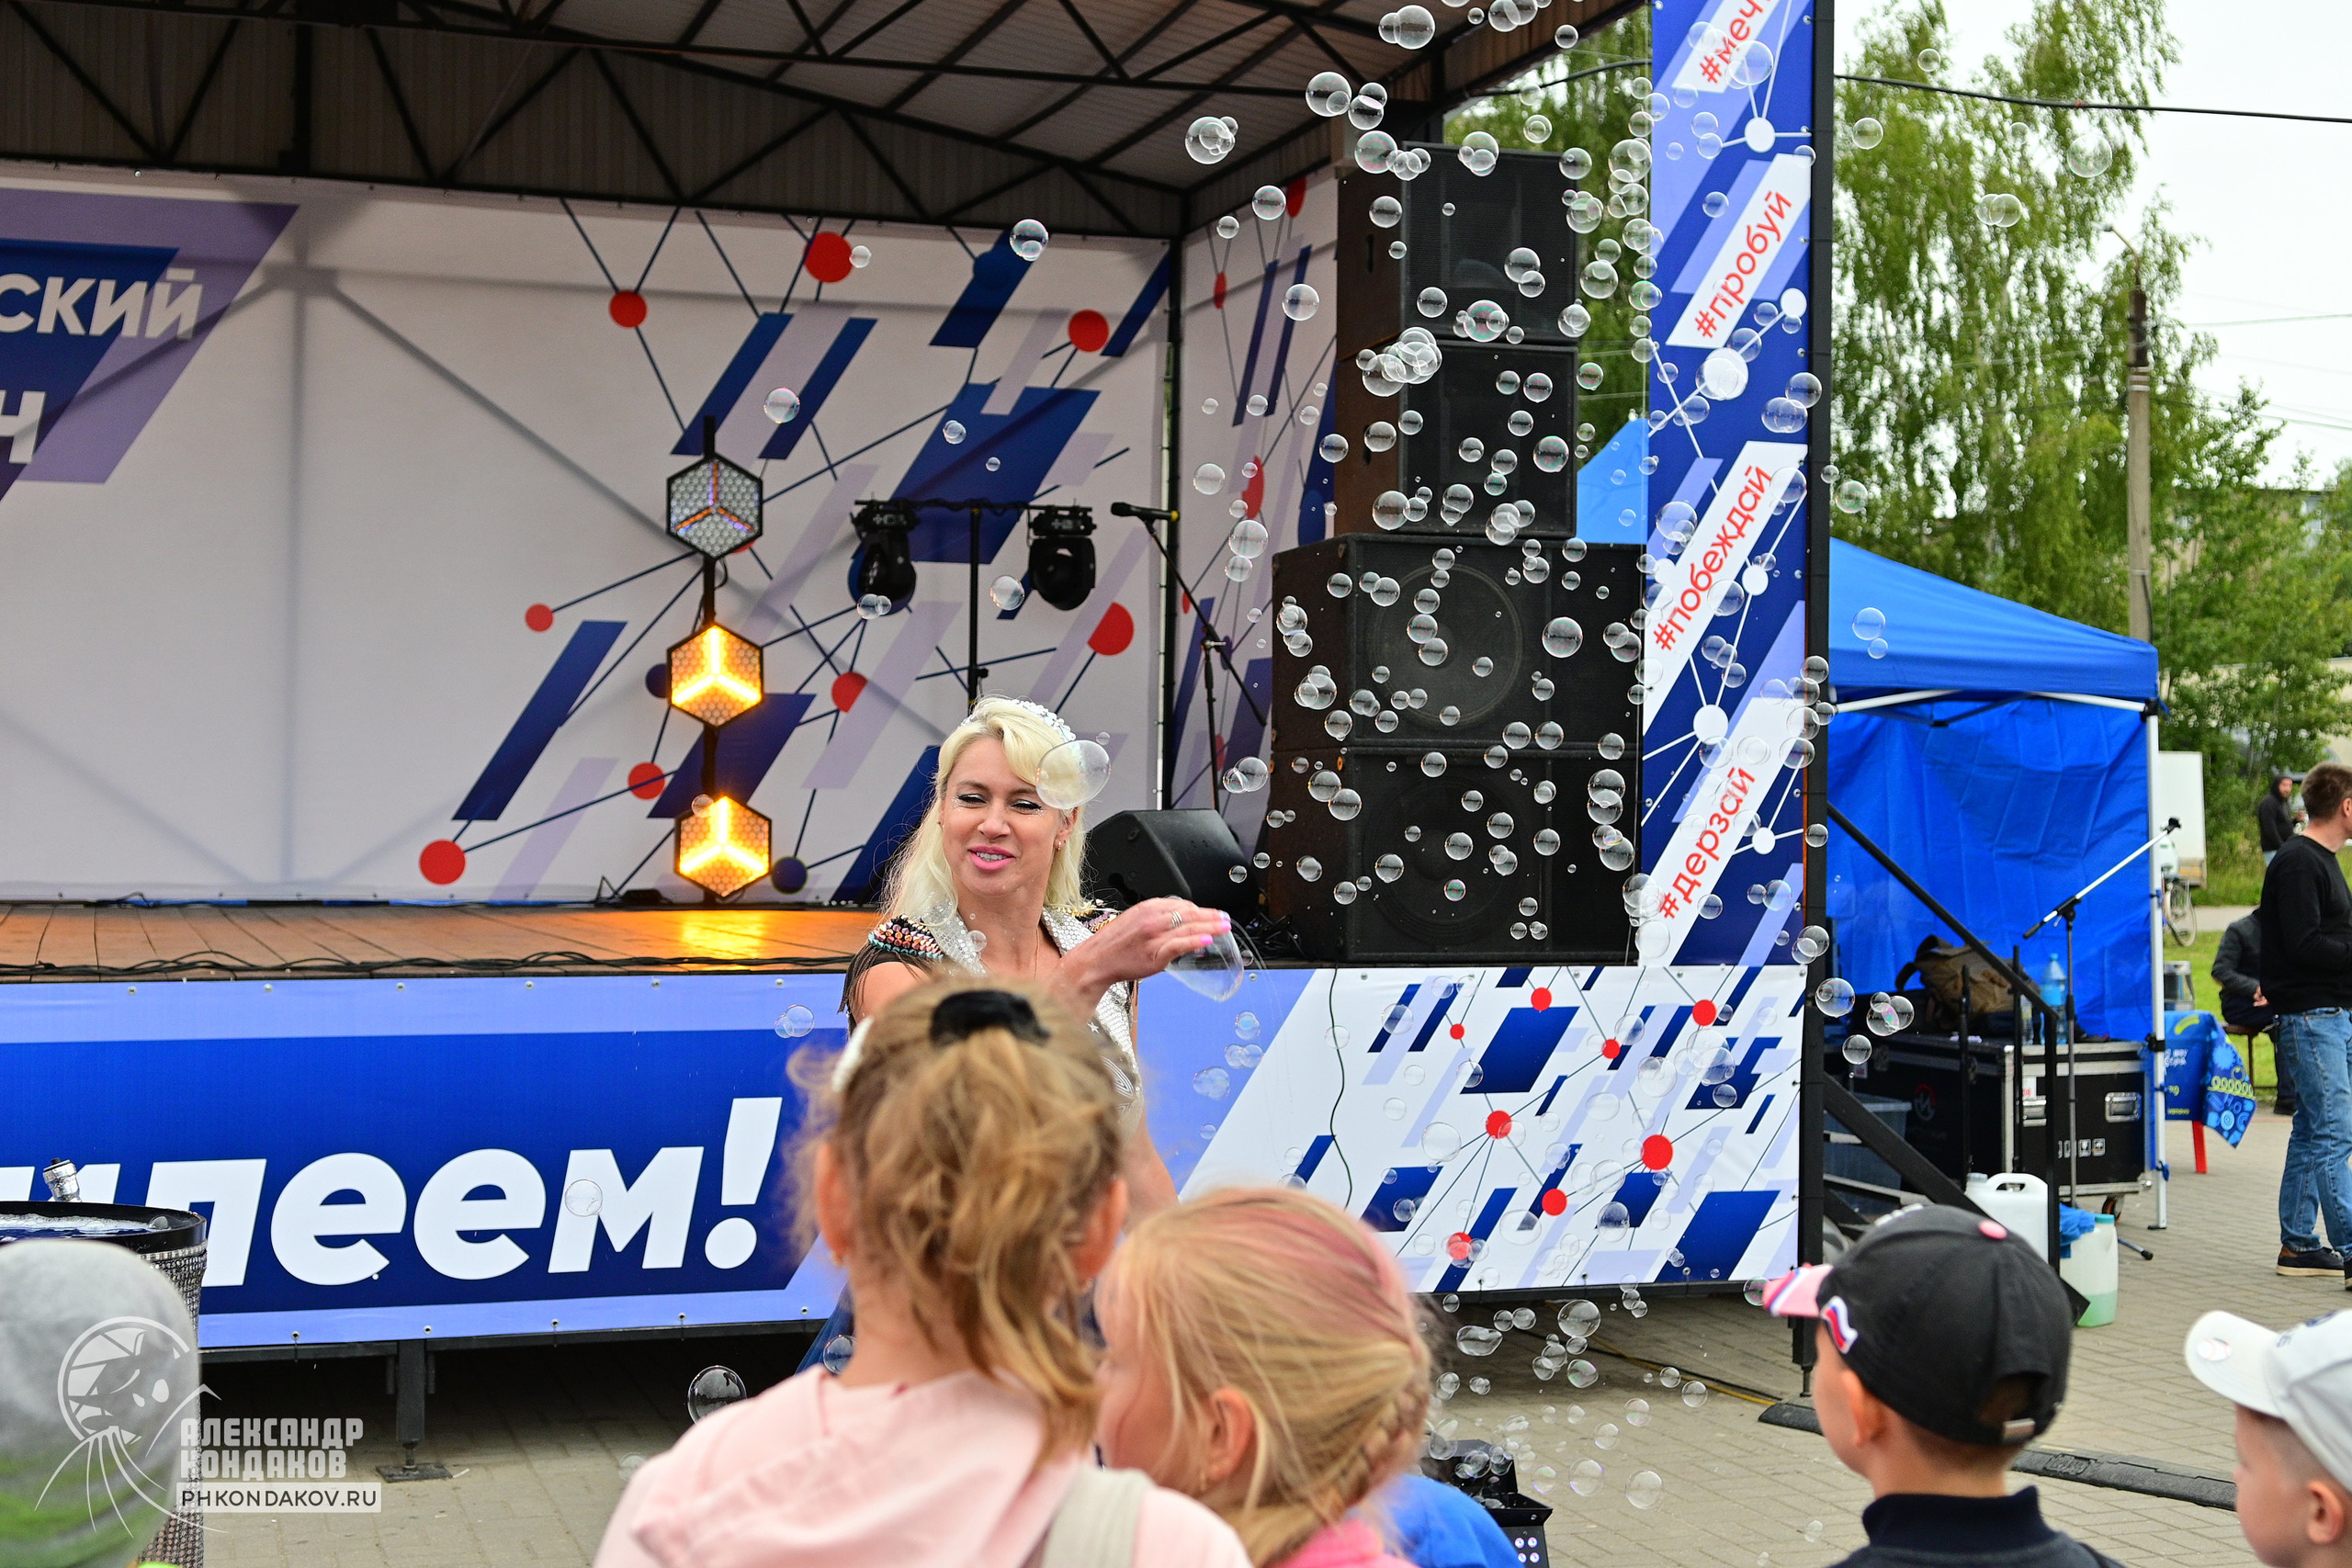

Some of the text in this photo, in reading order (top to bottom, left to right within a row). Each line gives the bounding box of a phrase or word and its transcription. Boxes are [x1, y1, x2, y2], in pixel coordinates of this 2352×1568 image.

[1700, 0, 1770, 84] #меч
[1695, 190, 1792, 339] #пробуй
[1654, 466, 1771, 650] #побеждай
[1659, 767, 1756, 919] #дерзай
